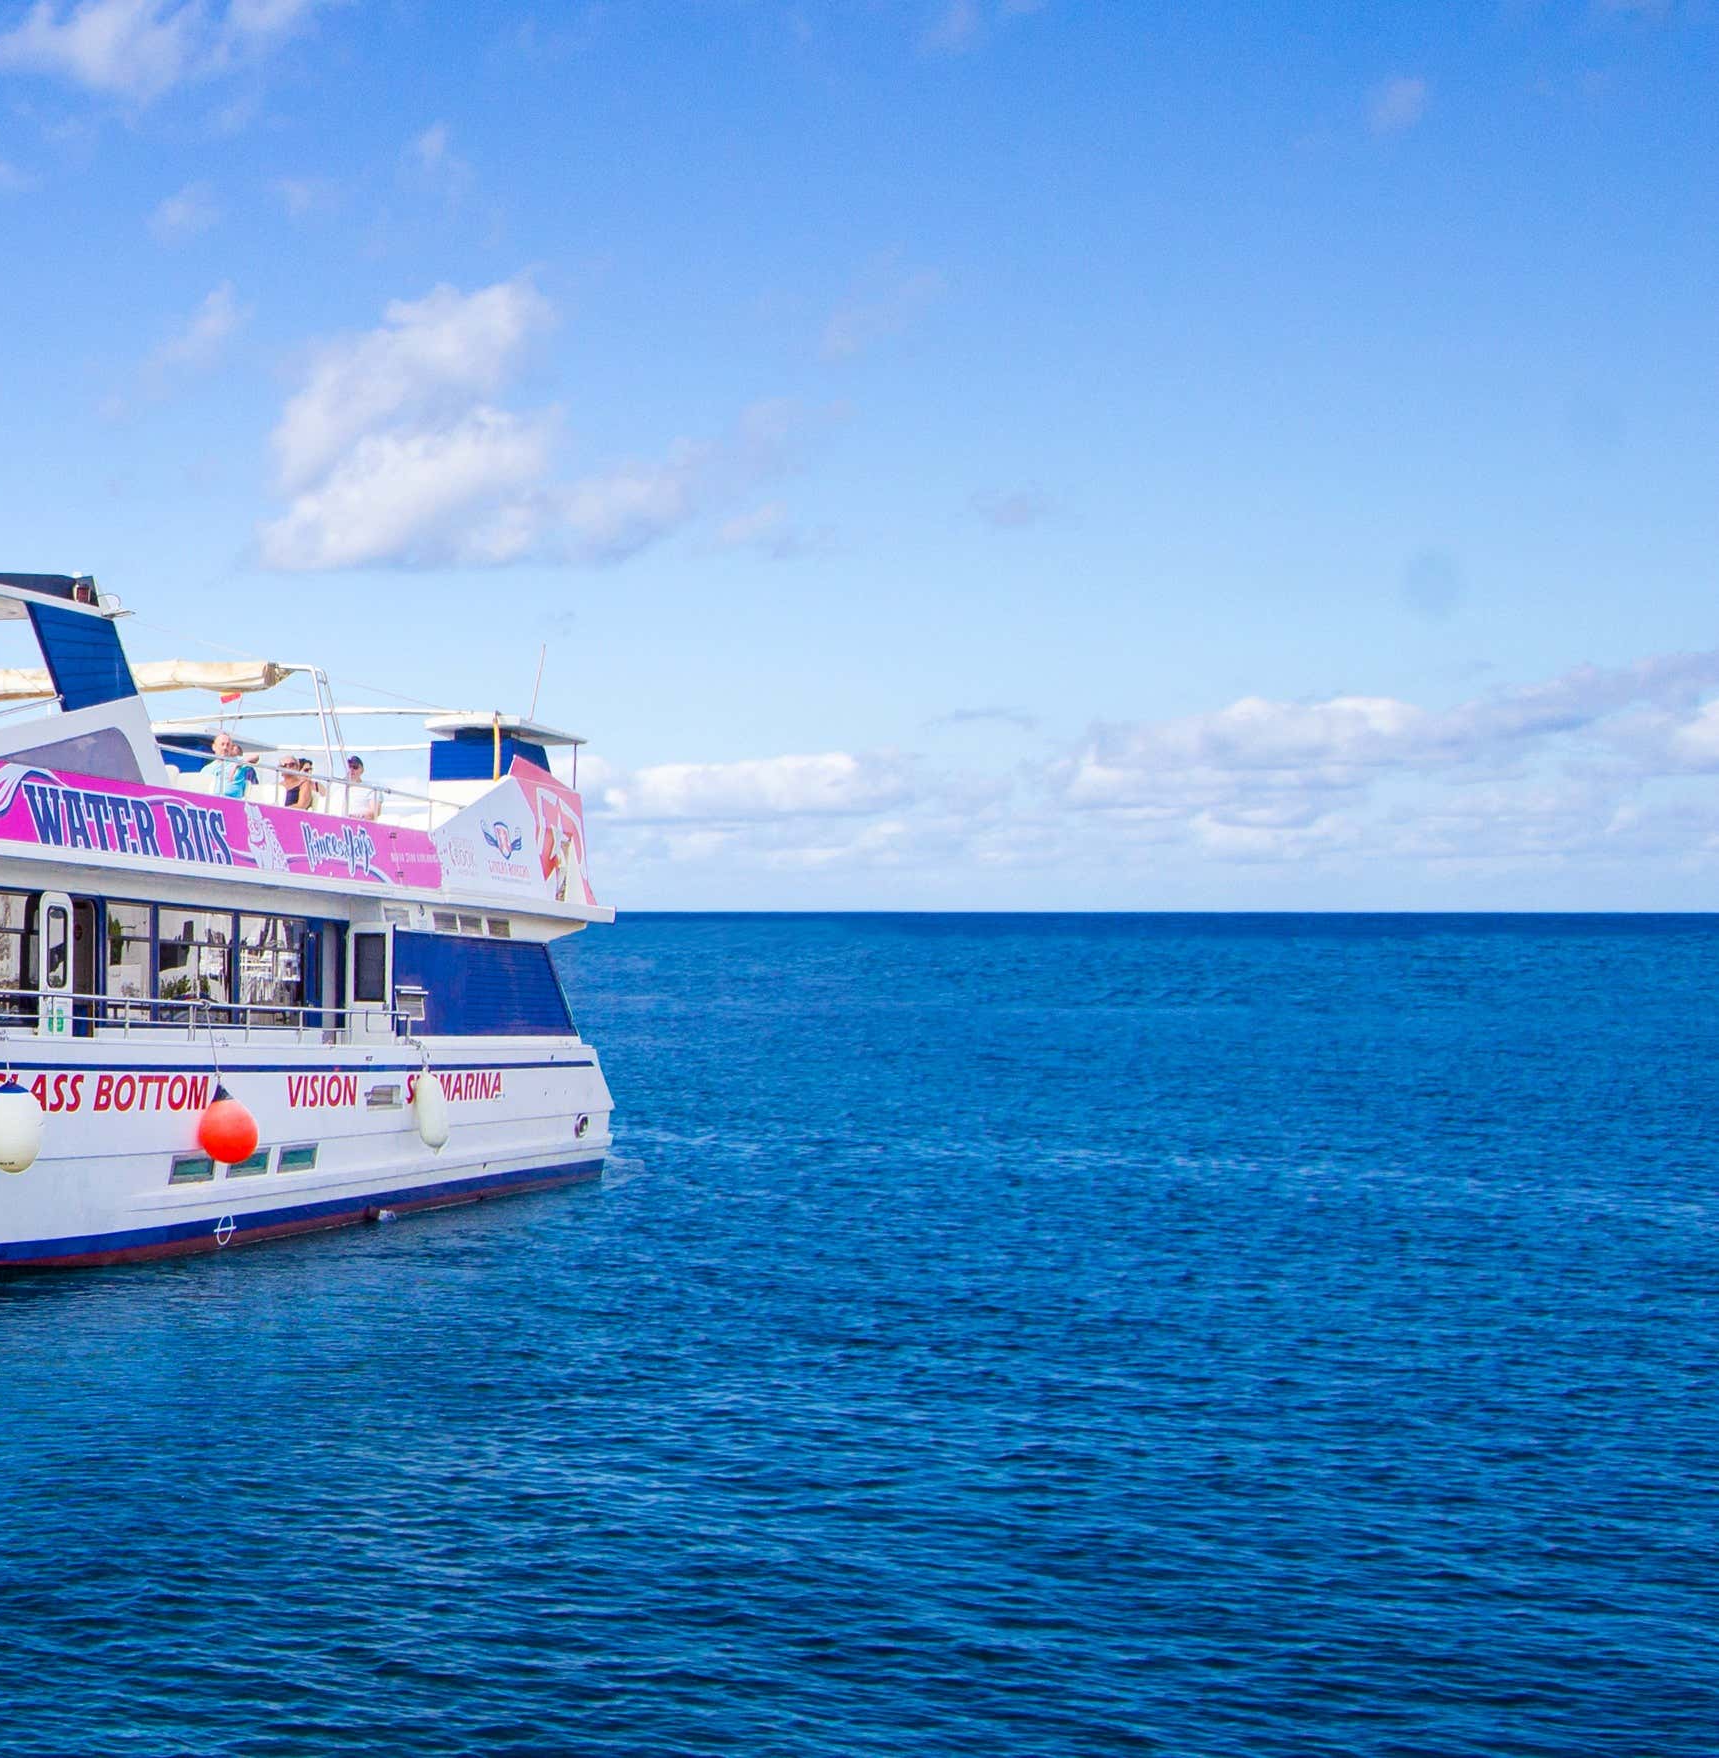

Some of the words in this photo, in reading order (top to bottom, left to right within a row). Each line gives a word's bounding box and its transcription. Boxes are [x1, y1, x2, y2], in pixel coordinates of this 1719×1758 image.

[22, 783, 161, 858] WATER
[165, 804, 233, 865] BUS
[93, 1074, 210, 1112] BOTTOM
[287, 1074, 358, 1108] VISION
[406, 1071, 502, 1105] SMARINA
